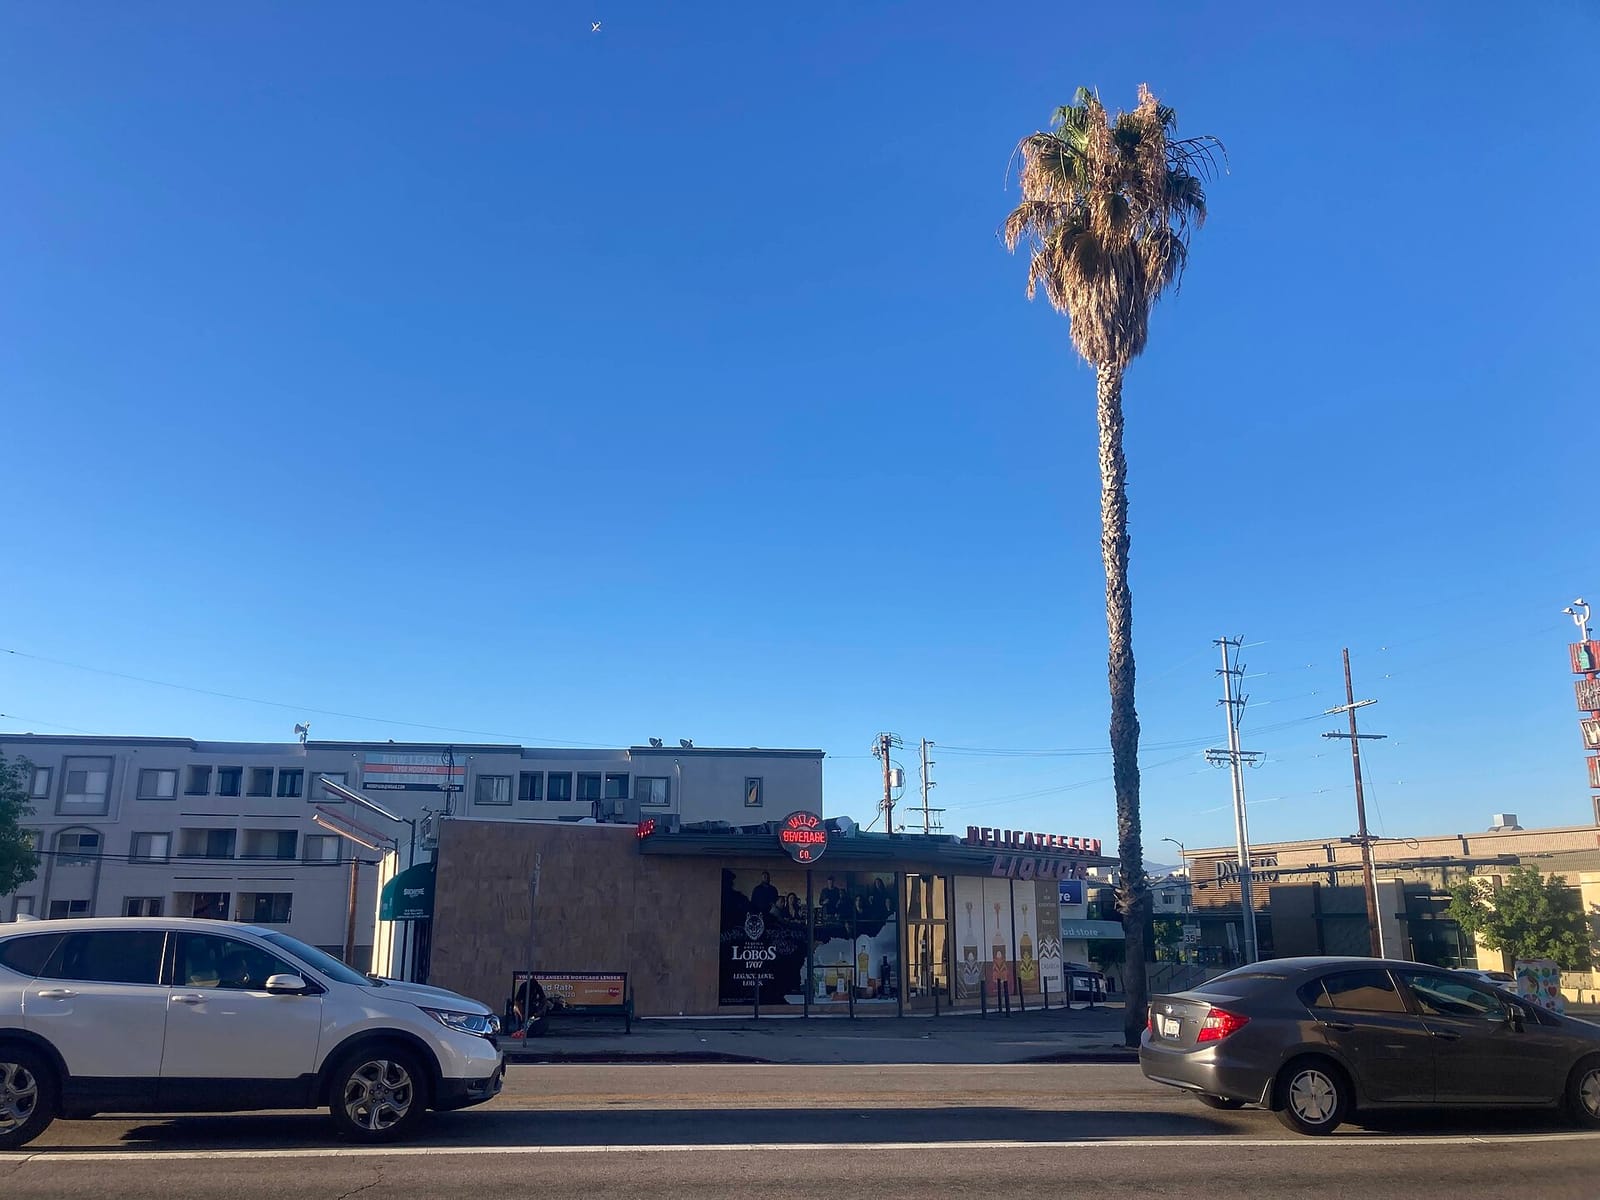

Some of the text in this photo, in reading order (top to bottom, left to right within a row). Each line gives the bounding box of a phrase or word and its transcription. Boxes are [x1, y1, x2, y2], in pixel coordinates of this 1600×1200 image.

[788, 814, 820, 828] VALLEY
[783, 830, 825, 843] BEVERAGE
[966, 825, 1102, 857] DELICATESSEN
[800, 850, 812, 859] CO.
[991, 855, 1088, 881] LIQUOR
[1077, 927, 1099, 936] store
[1185, 934, 1197, 944] 35
[731, 945, 777, 961] LOBOS
[745, 961, 763, 969] 1707
